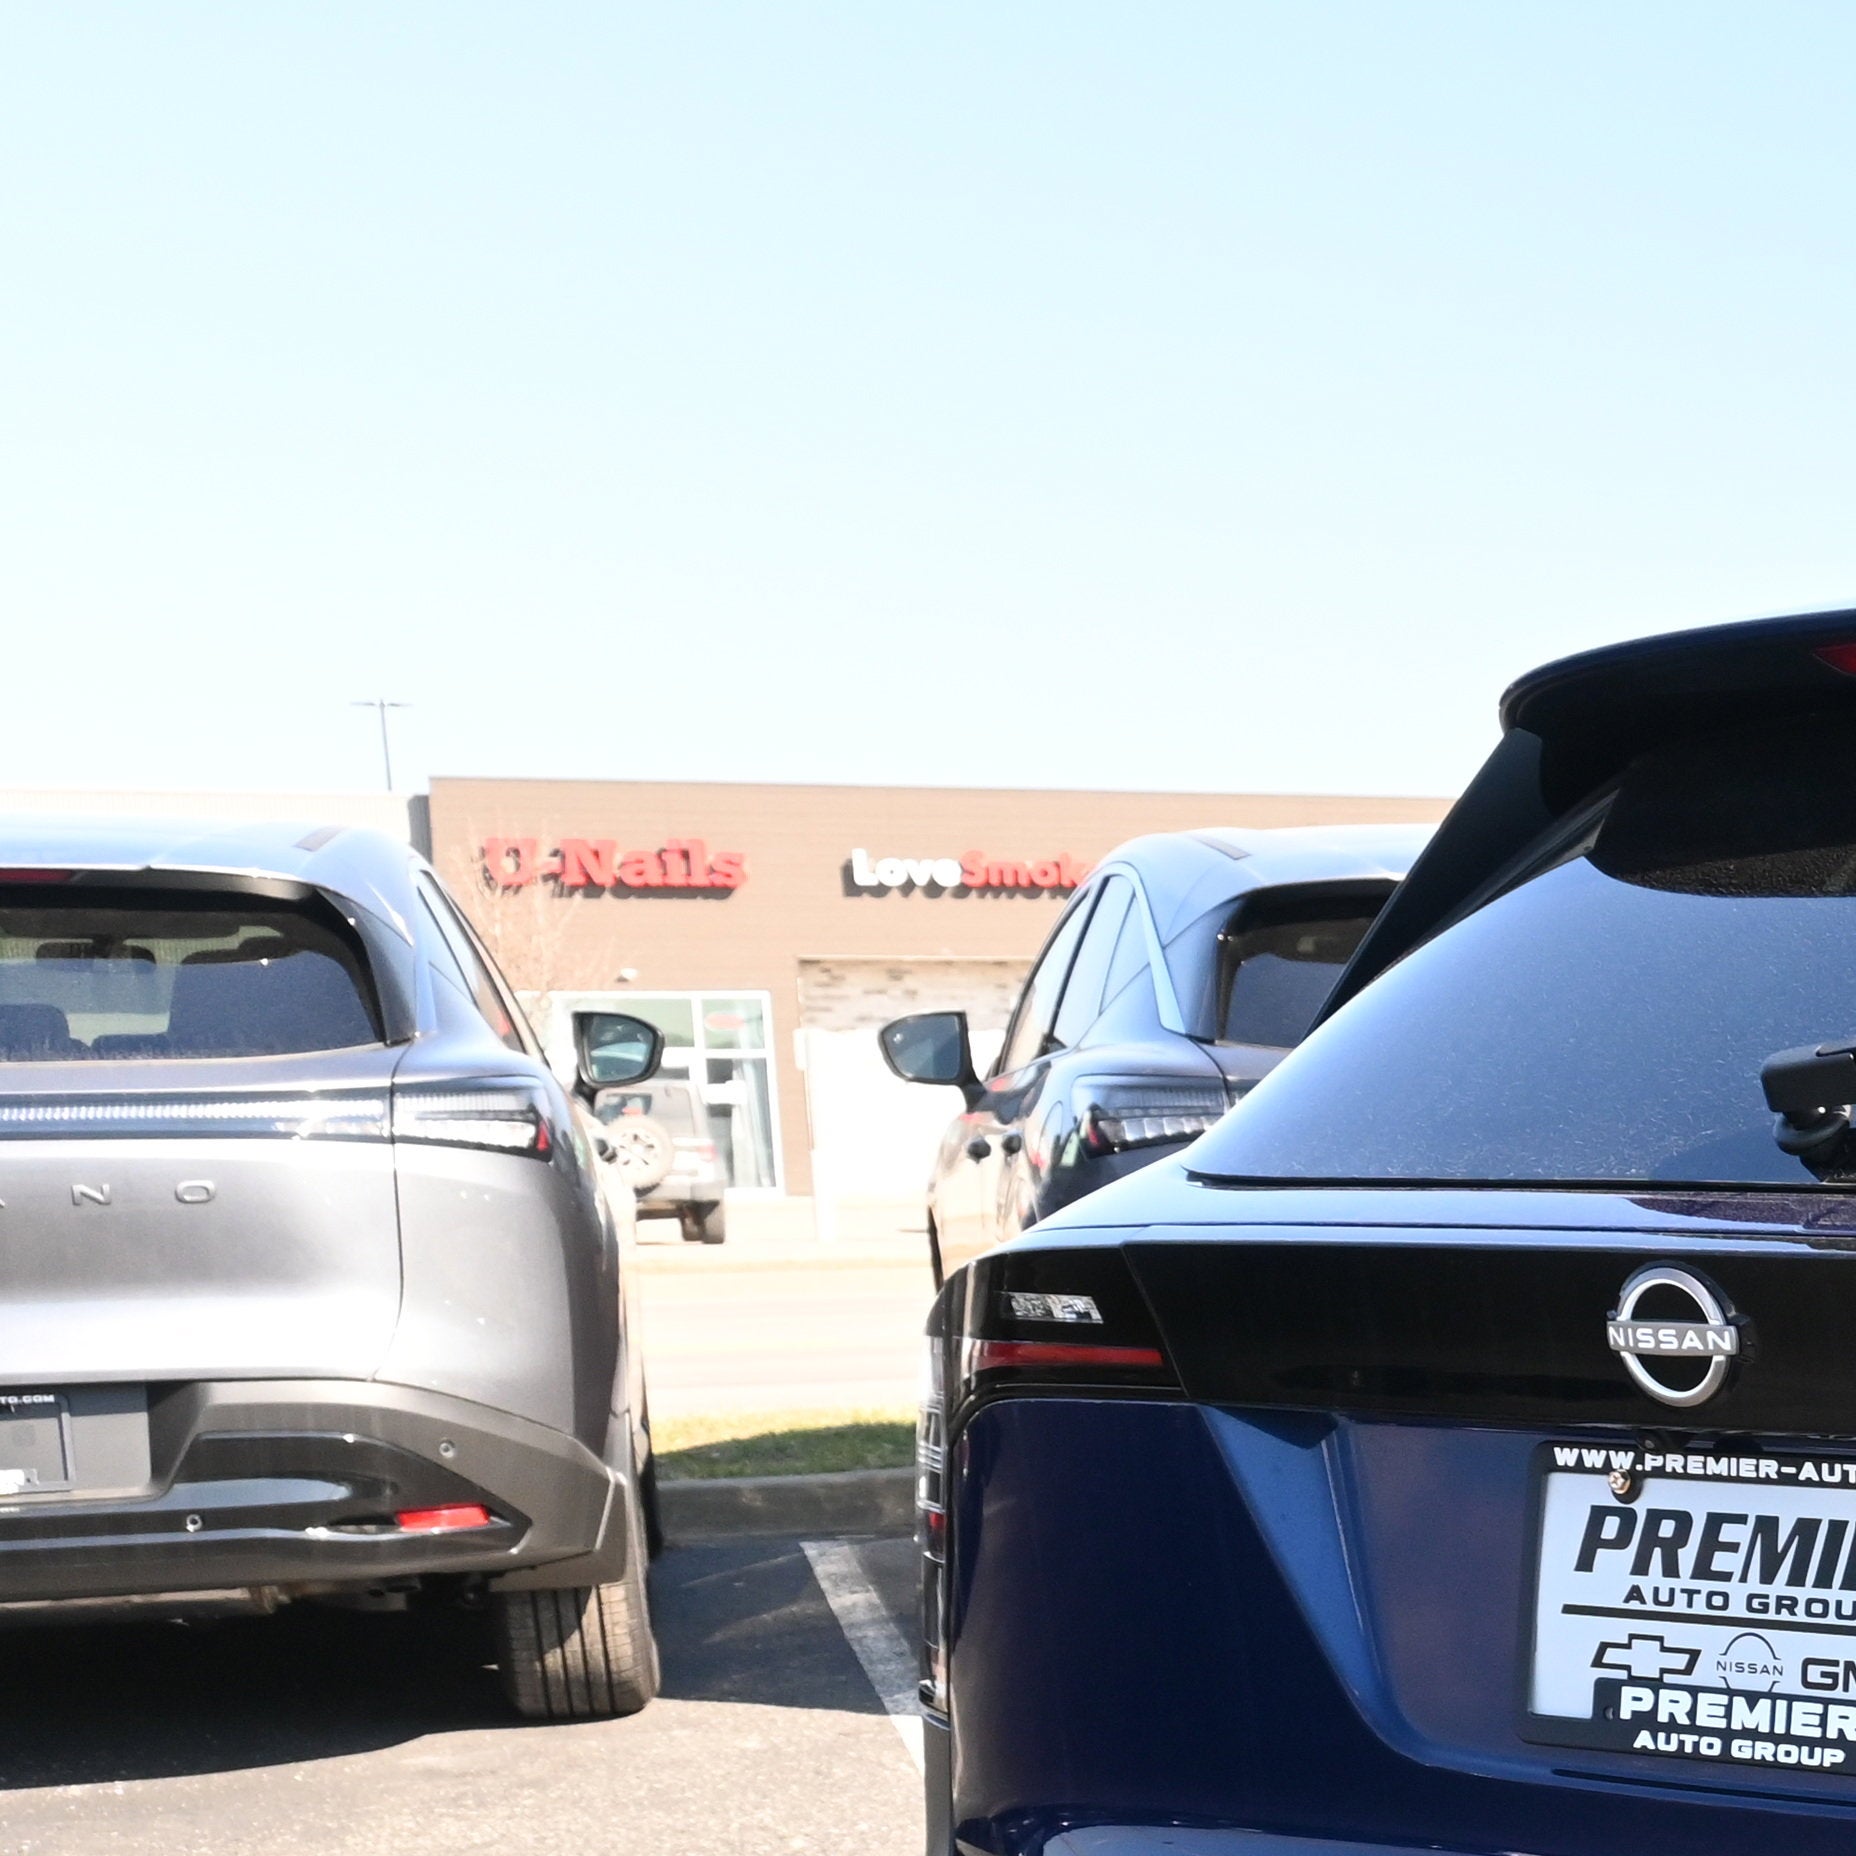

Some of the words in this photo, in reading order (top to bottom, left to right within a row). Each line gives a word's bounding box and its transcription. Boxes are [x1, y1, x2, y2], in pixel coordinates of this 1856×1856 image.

[851, 848, 1101, 888] LoveSmok
[1608, 1326, 1732, 1350] NISSAN
[1623, 1584, 1731, 1612] AUTO
[1716, 1659, 1784, 1677] NISSAN
[1633, 1729, 1723, 1757] AUTO
[1730, 1737, 1846, 1768] GROUP
